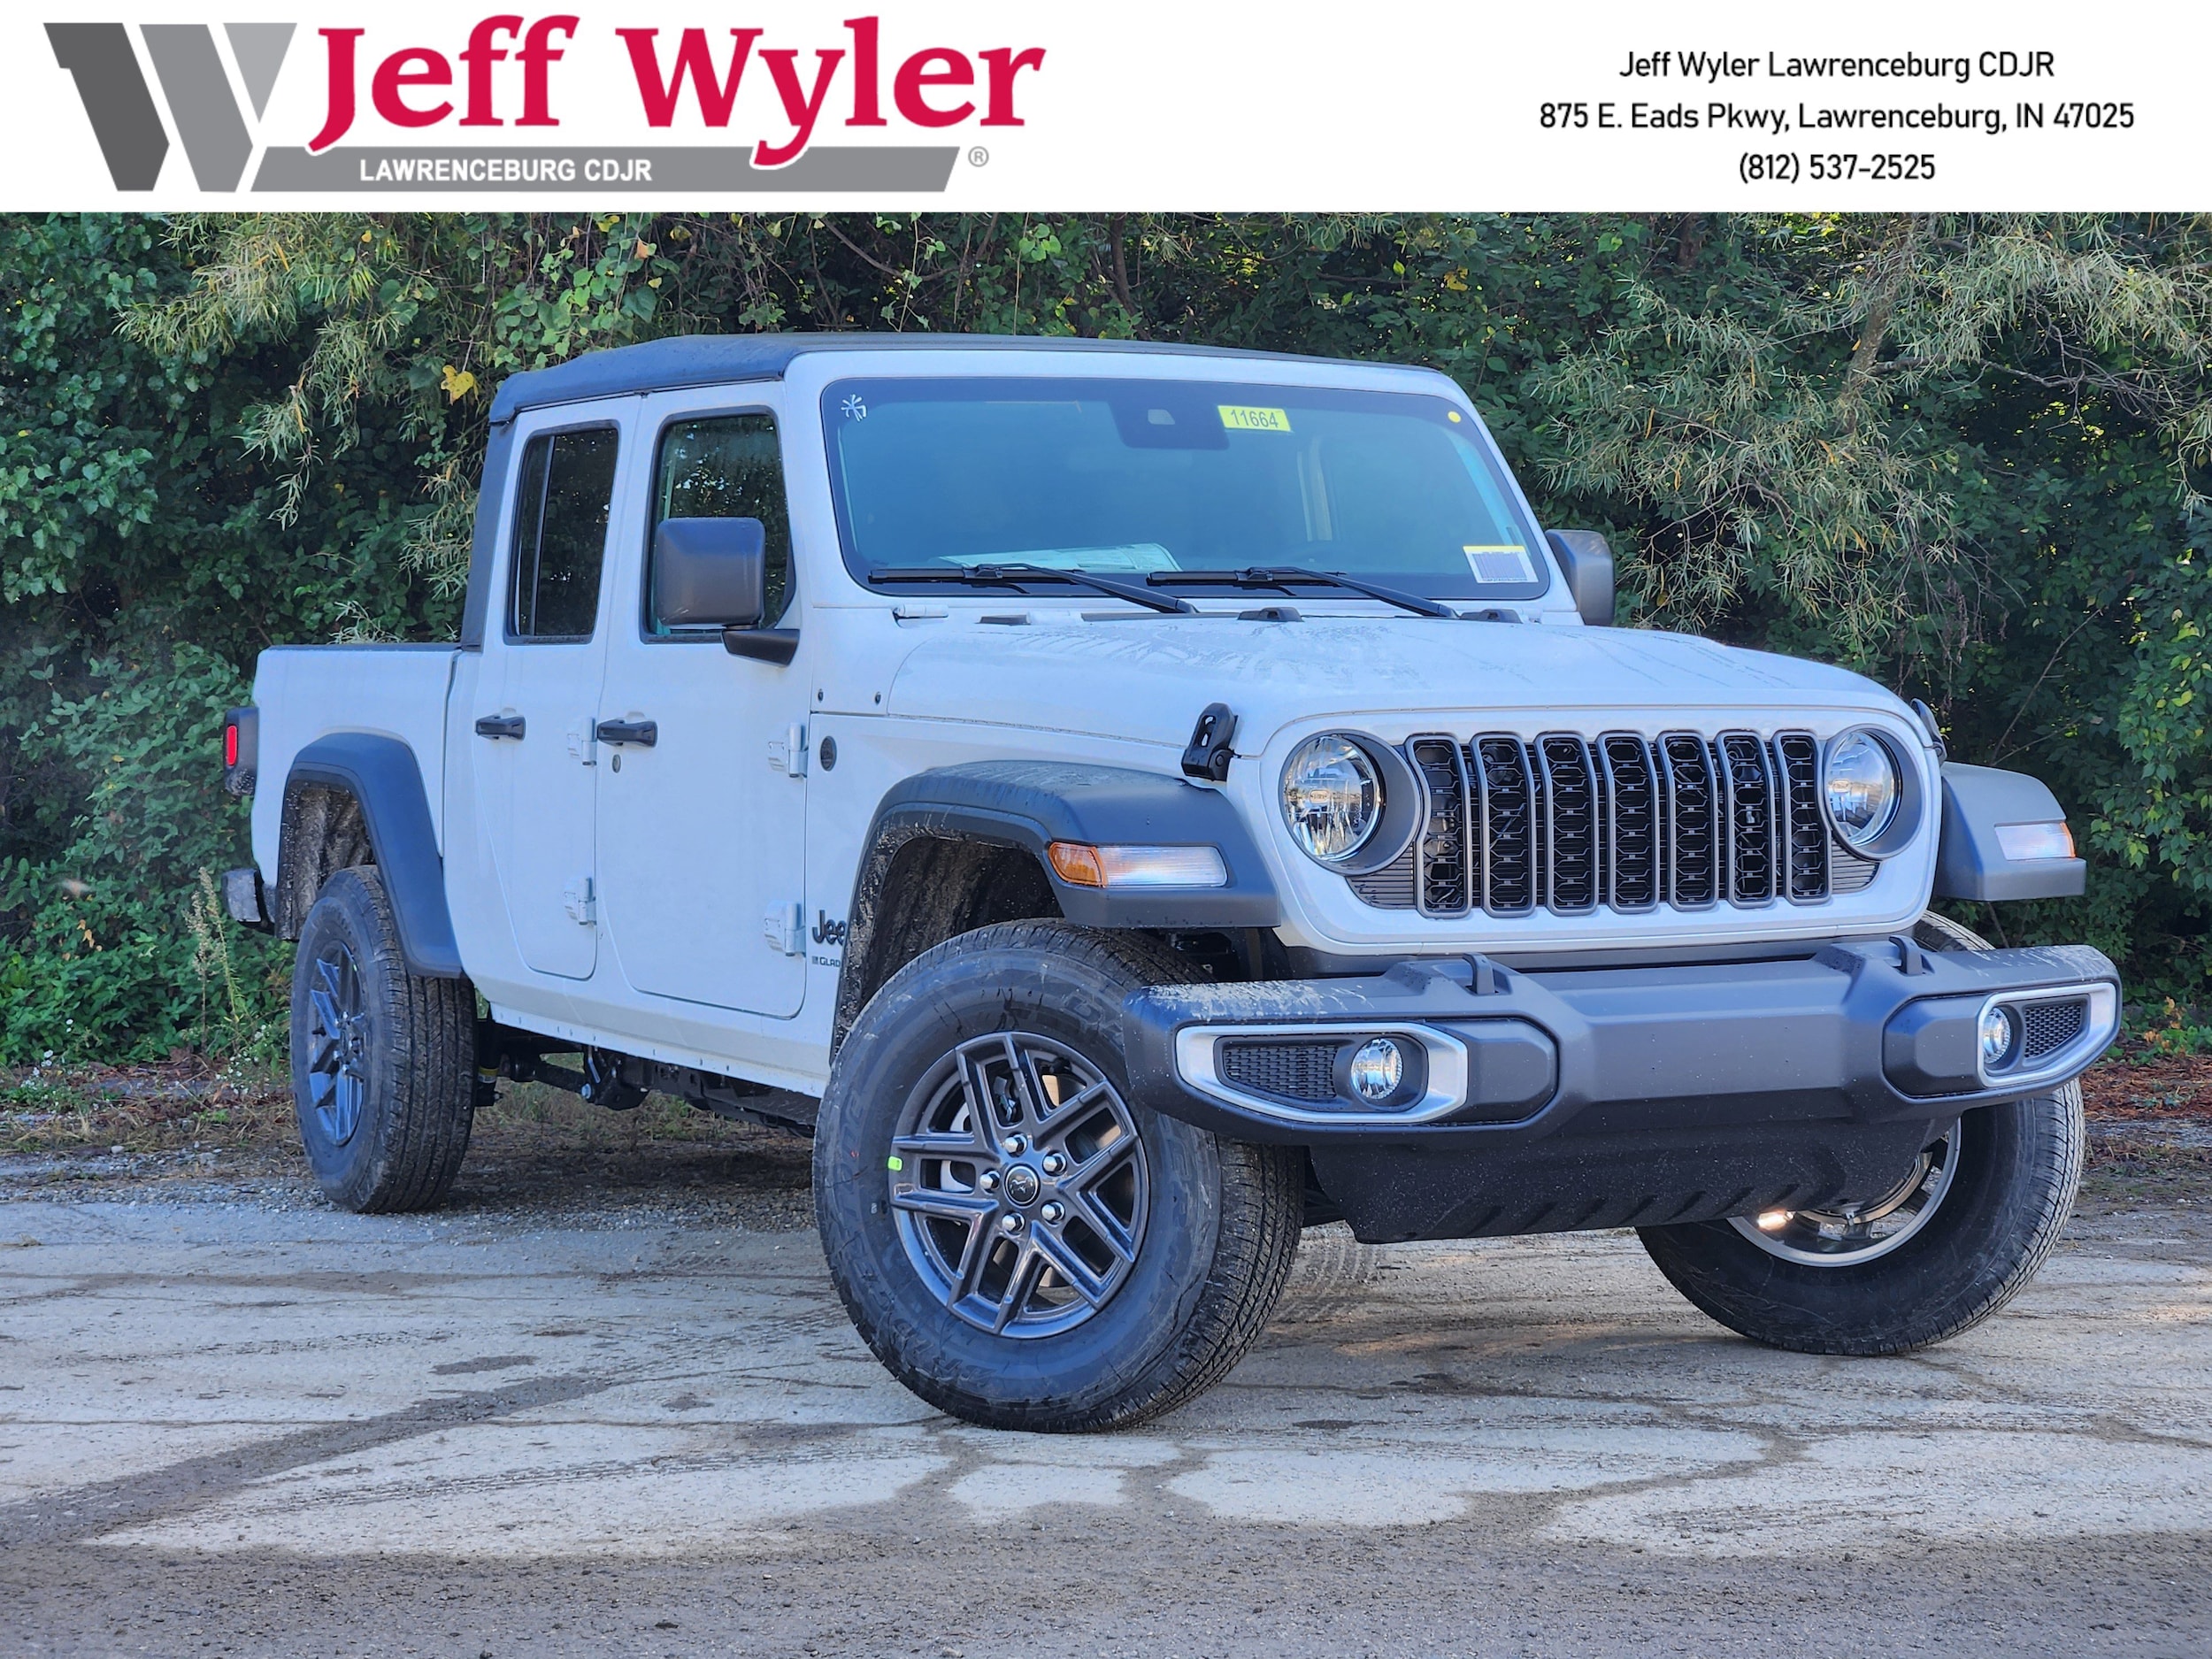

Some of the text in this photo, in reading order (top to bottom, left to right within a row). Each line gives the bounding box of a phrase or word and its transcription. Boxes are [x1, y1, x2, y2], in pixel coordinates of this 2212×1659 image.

[1231, 410, 1279, 428] 11664
[811, 910, 847, 946] Jee
[818, 956, 841, 968] GLAD
